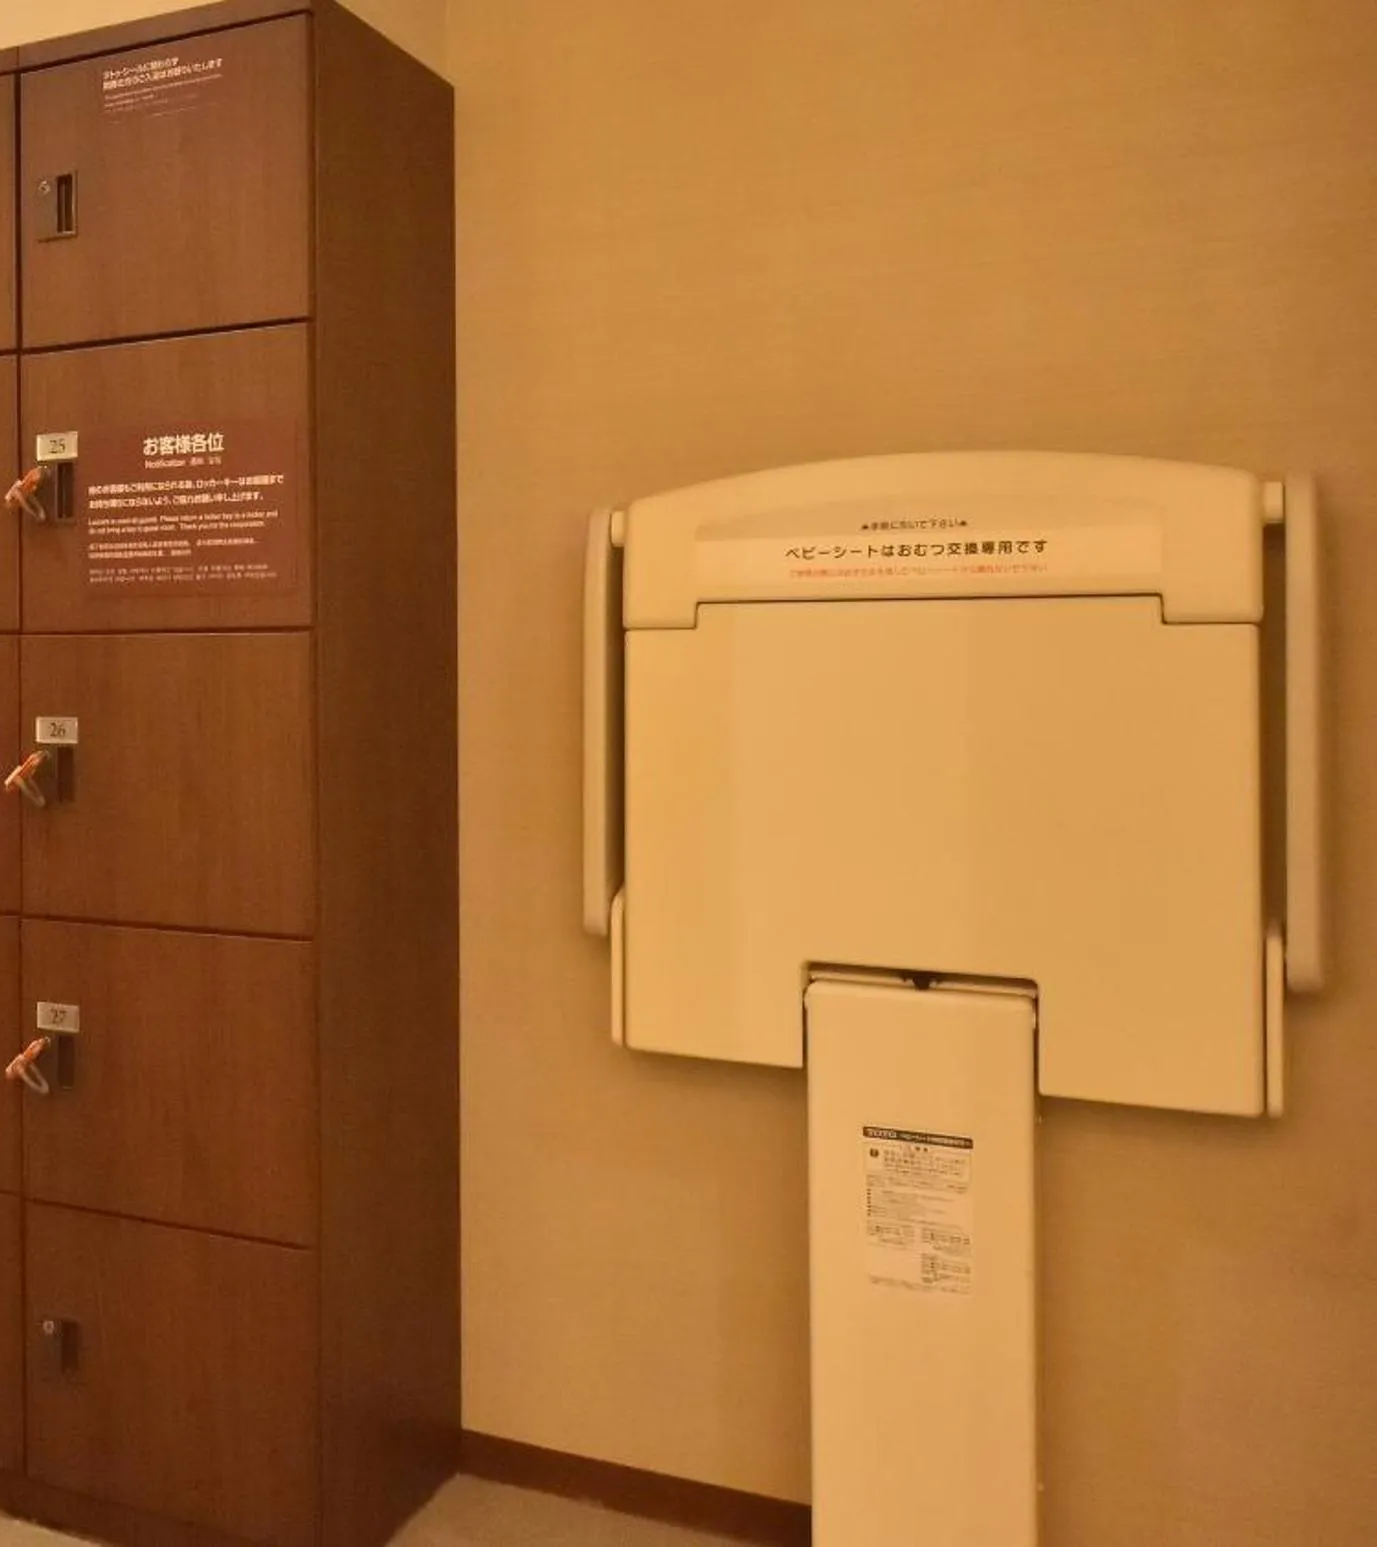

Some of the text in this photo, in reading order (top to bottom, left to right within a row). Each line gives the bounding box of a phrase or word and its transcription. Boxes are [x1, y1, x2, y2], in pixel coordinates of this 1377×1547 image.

[49, 438, 66, 454] 25
[142, 432, 224, 456] お客様各位
[49, 722, 66, 738] 26
[51, 1009, 67, 1025] 27
